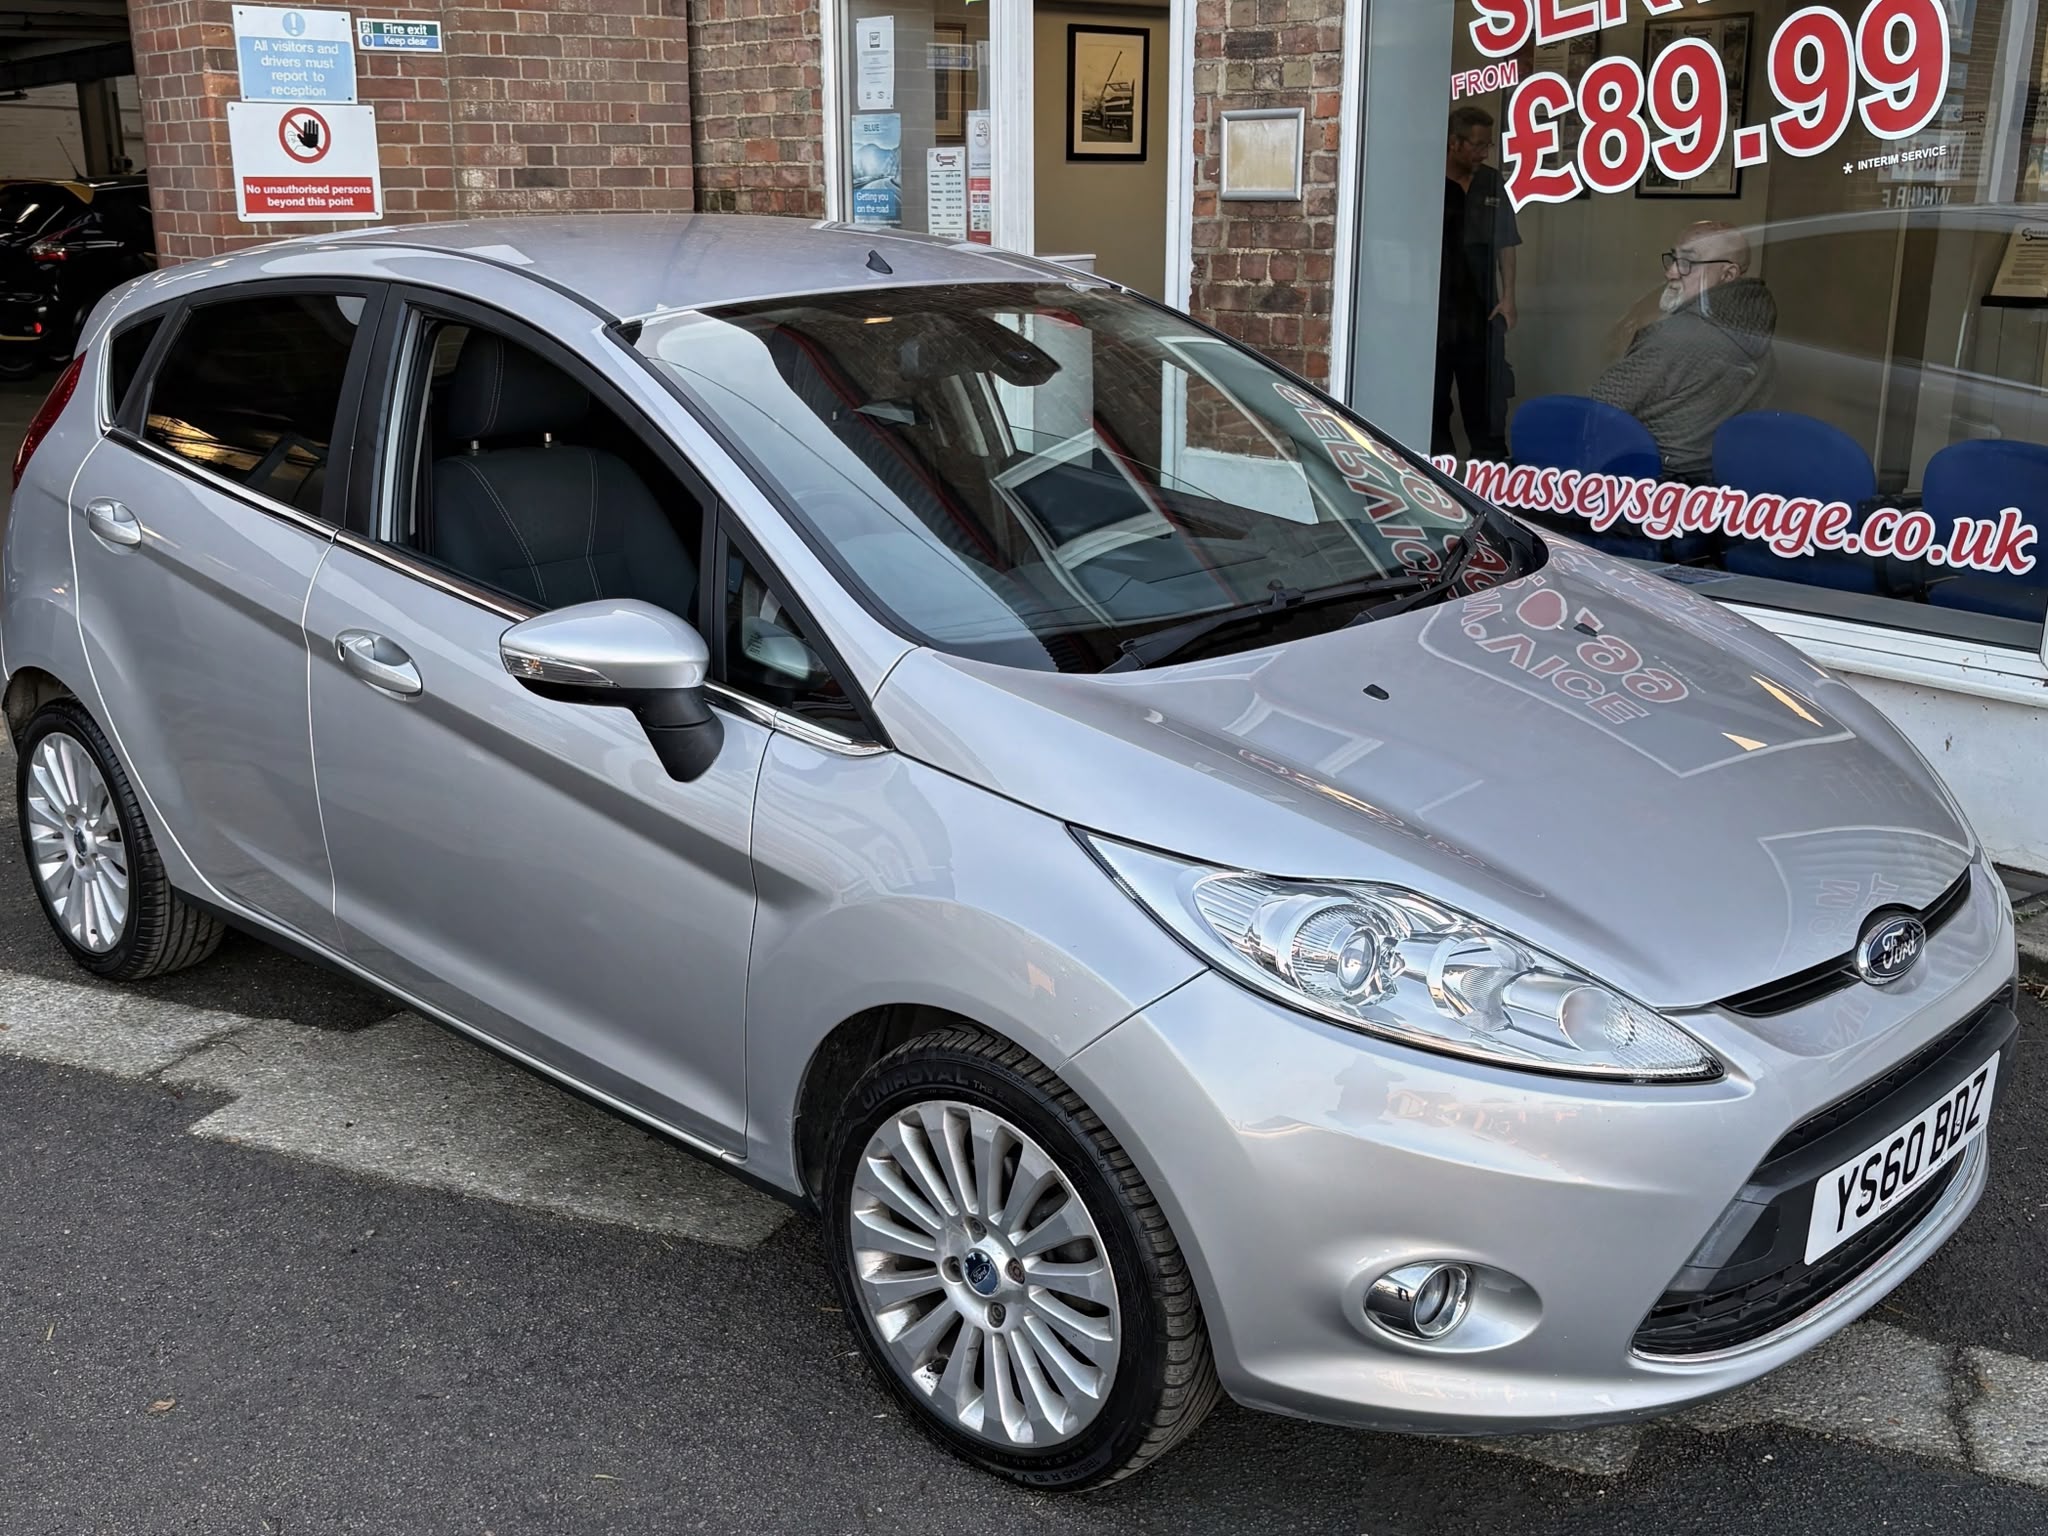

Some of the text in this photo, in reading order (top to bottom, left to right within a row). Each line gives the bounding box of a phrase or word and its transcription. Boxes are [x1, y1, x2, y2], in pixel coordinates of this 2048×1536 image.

[383, 23, 428, 35] Fire exit
[253, 40, 339, 55] All visitors and
[384, 36, 429, 46] Keep clear
[261, 55, 335, 69] drivers must
[271, 71, 325, 84] report to
[1452, 59, 1518, 100] FROM
[271, 85, 327, 99] reception
[1502, 0, 1950, 213] £89.99
[1858, 154, 1899, 171] INTERIM
[1902, 145, 1947, 162] SERVICE
[246, 184, 372, 196] No unauthorised persons
[267, 197, 354, 208] beyond this point
[856, 192, 889, 204] Getting you
[866, 205, 875, 213] the
[875, 205, 889, 213] road
[1882, 927, 1917, 970] Ford
[1836, 1067, 1988, 1234] YS60 BDZ
